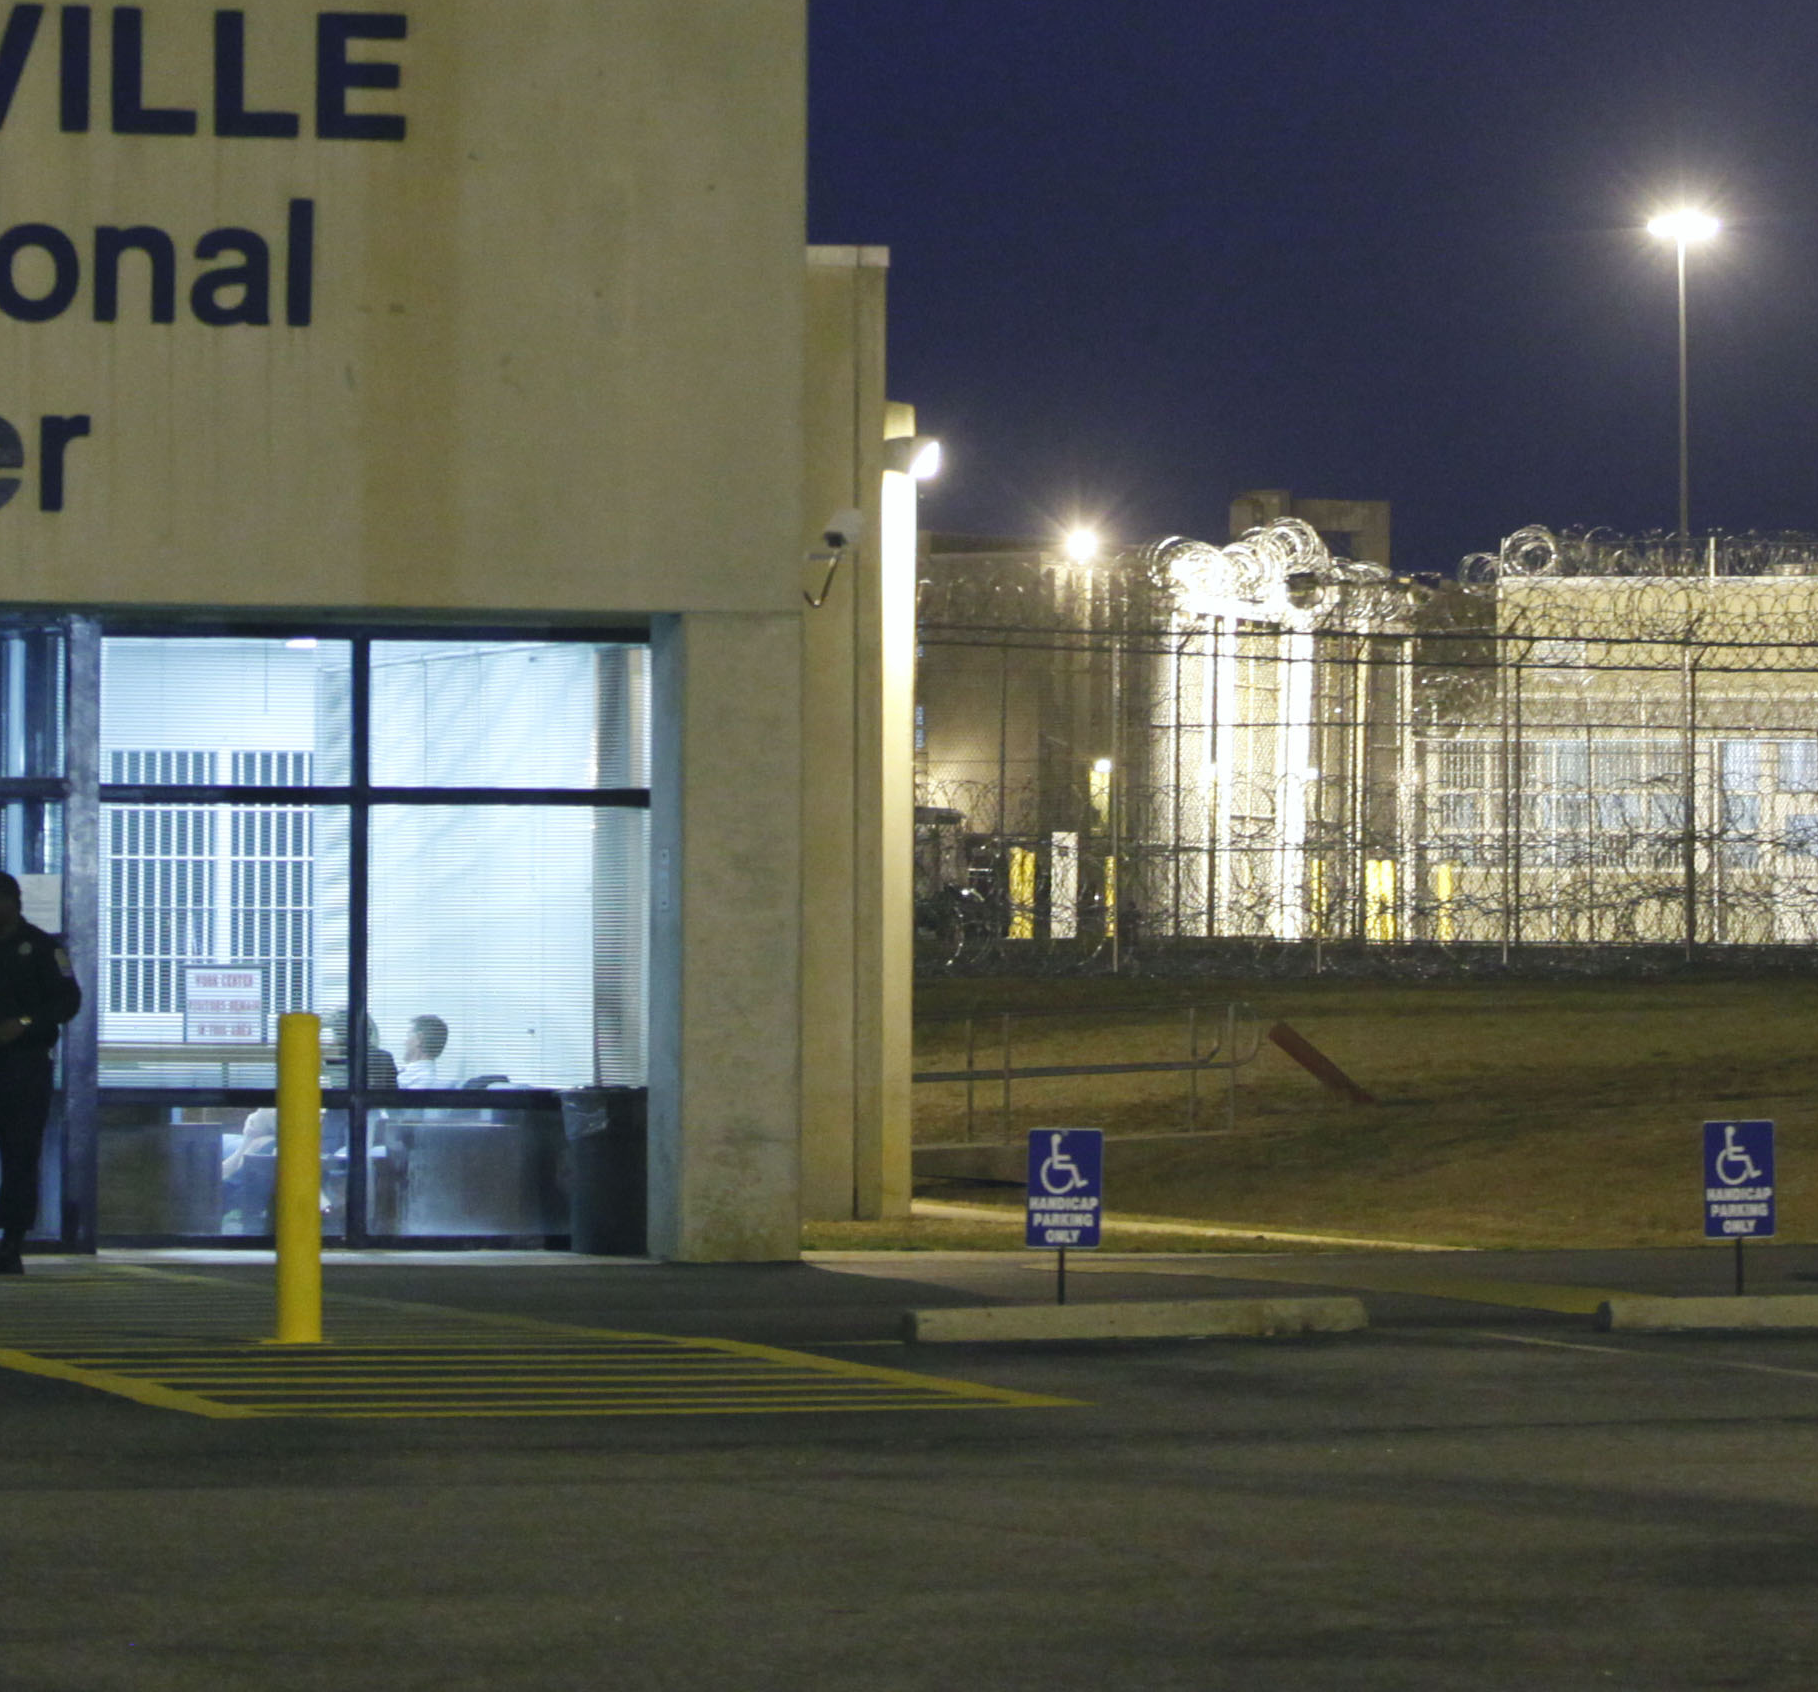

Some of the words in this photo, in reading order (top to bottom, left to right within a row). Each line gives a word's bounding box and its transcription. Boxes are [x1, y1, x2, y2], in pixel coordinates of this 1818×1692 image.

[1706, 1188, 1772, 1202] HANDICAP
[1029, 1197, 1099, 1211] HANDICAP
[1710, 1203, 1769, 1218] PARKING
[1032, 1213, 1094, 1227] PARKING
[1723, 1219, 1757, 1234] ONLY
[1045, 1229, 1081, 1243] ONLY
